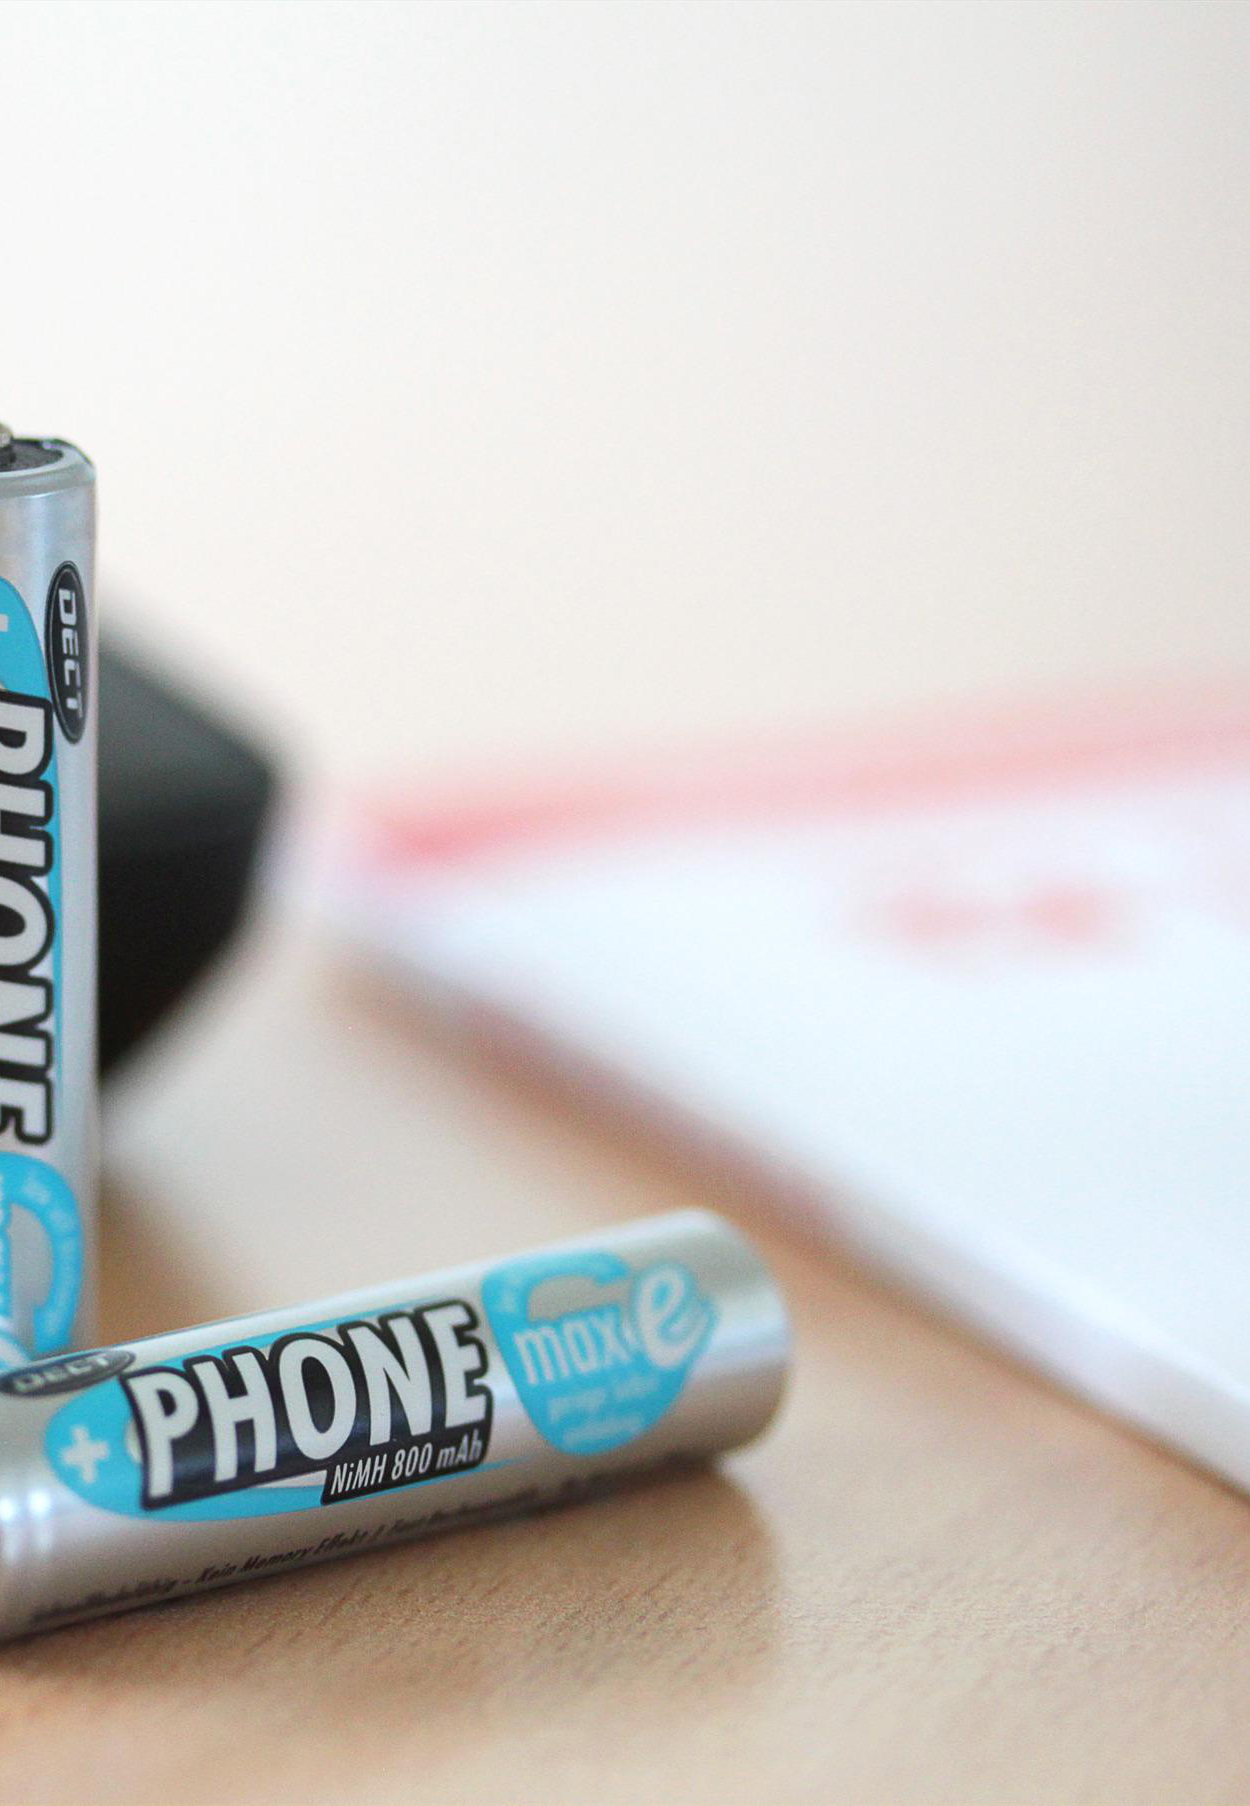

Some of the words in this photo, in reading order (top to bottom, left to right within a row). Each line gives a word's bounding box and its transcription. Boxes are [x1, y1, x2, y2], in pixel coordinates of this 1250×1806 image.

[58, 587, 84, 720] DECT
[13, 1352, 109, 1393] DECT
[125, 1302, 487, 1500] PHONE
[330, 1453, 387, 1495] NiMH
[391, 1442, 433, 1480] 800
[435, 1428, 483, 1470] mAh
